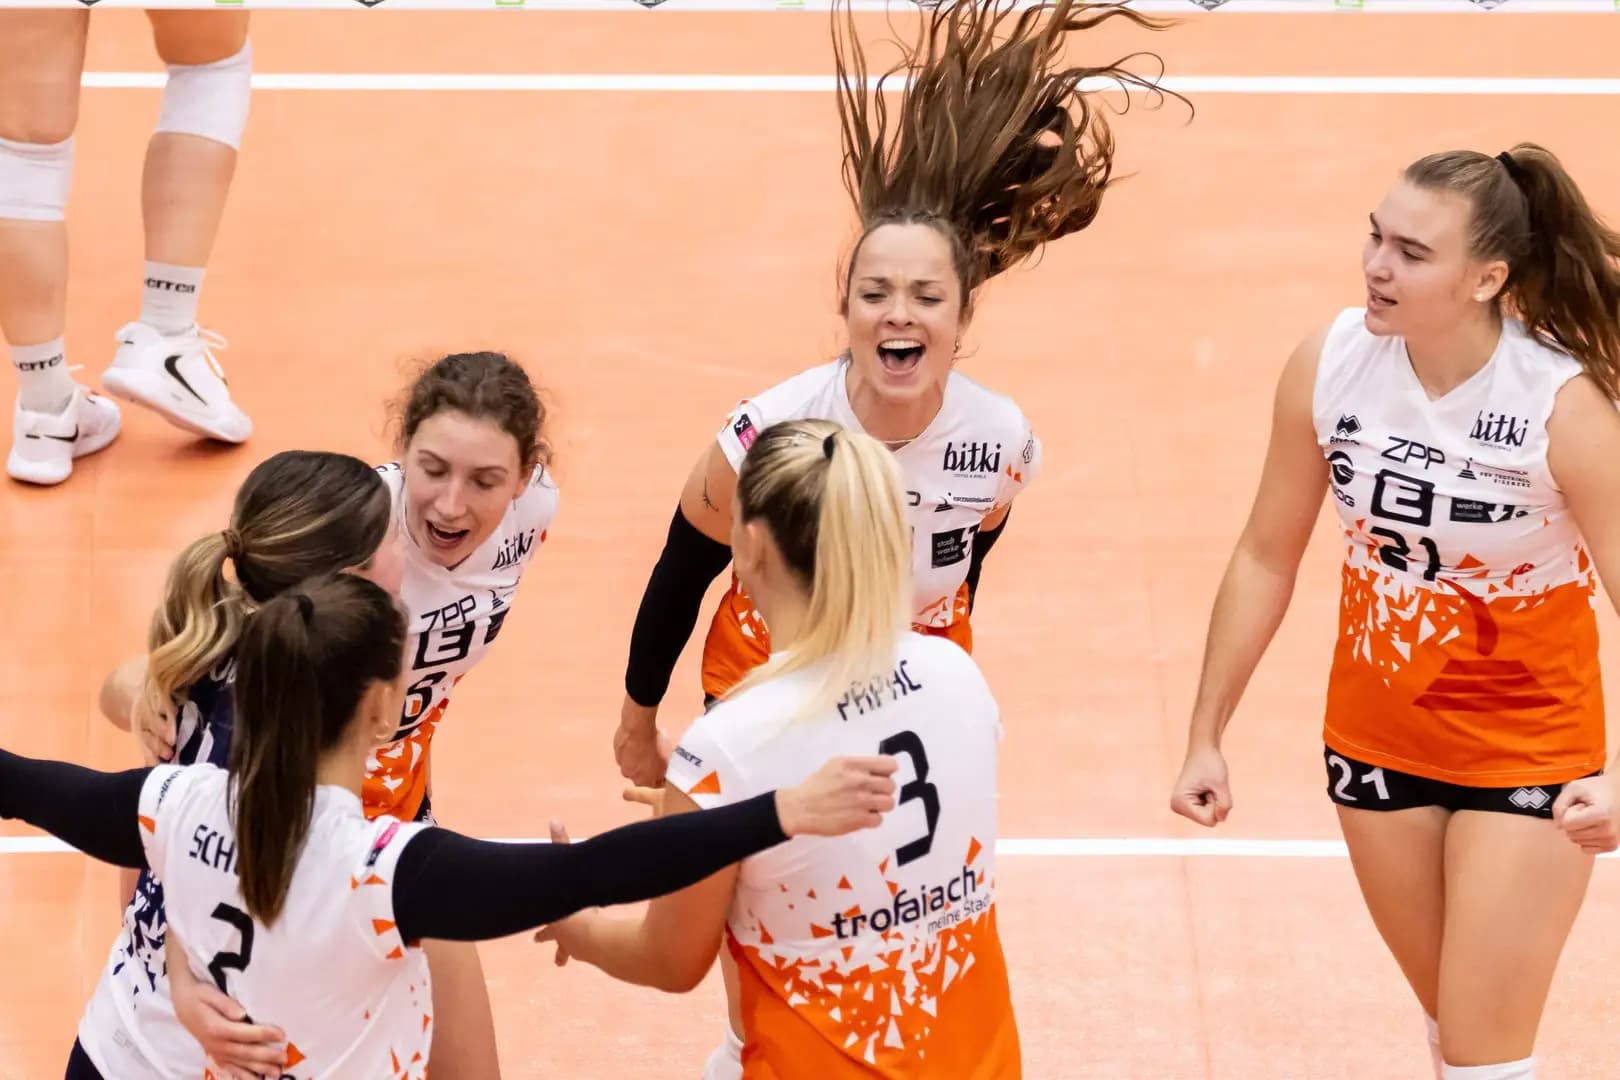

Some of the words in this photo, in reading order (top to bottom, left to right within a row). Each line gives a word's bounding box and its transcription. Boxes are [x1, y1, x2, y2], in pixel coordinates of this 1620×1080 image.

[1381, 436, 1446, 470] ZPP
[1469, 409, 1529, 447] bitki
[943, 442, 1002, 473] bitki
[1369, 526, 1442, 582] 21
[879, 730, 941, 868] 3
[1328, 754, 1390, 801] 21
[189, 823, 240, 877] SCH
[831, 865, 976, 940] trofaiach
[927, 908, 961, 934] meine
[207, 901, 255, 1025] 2
